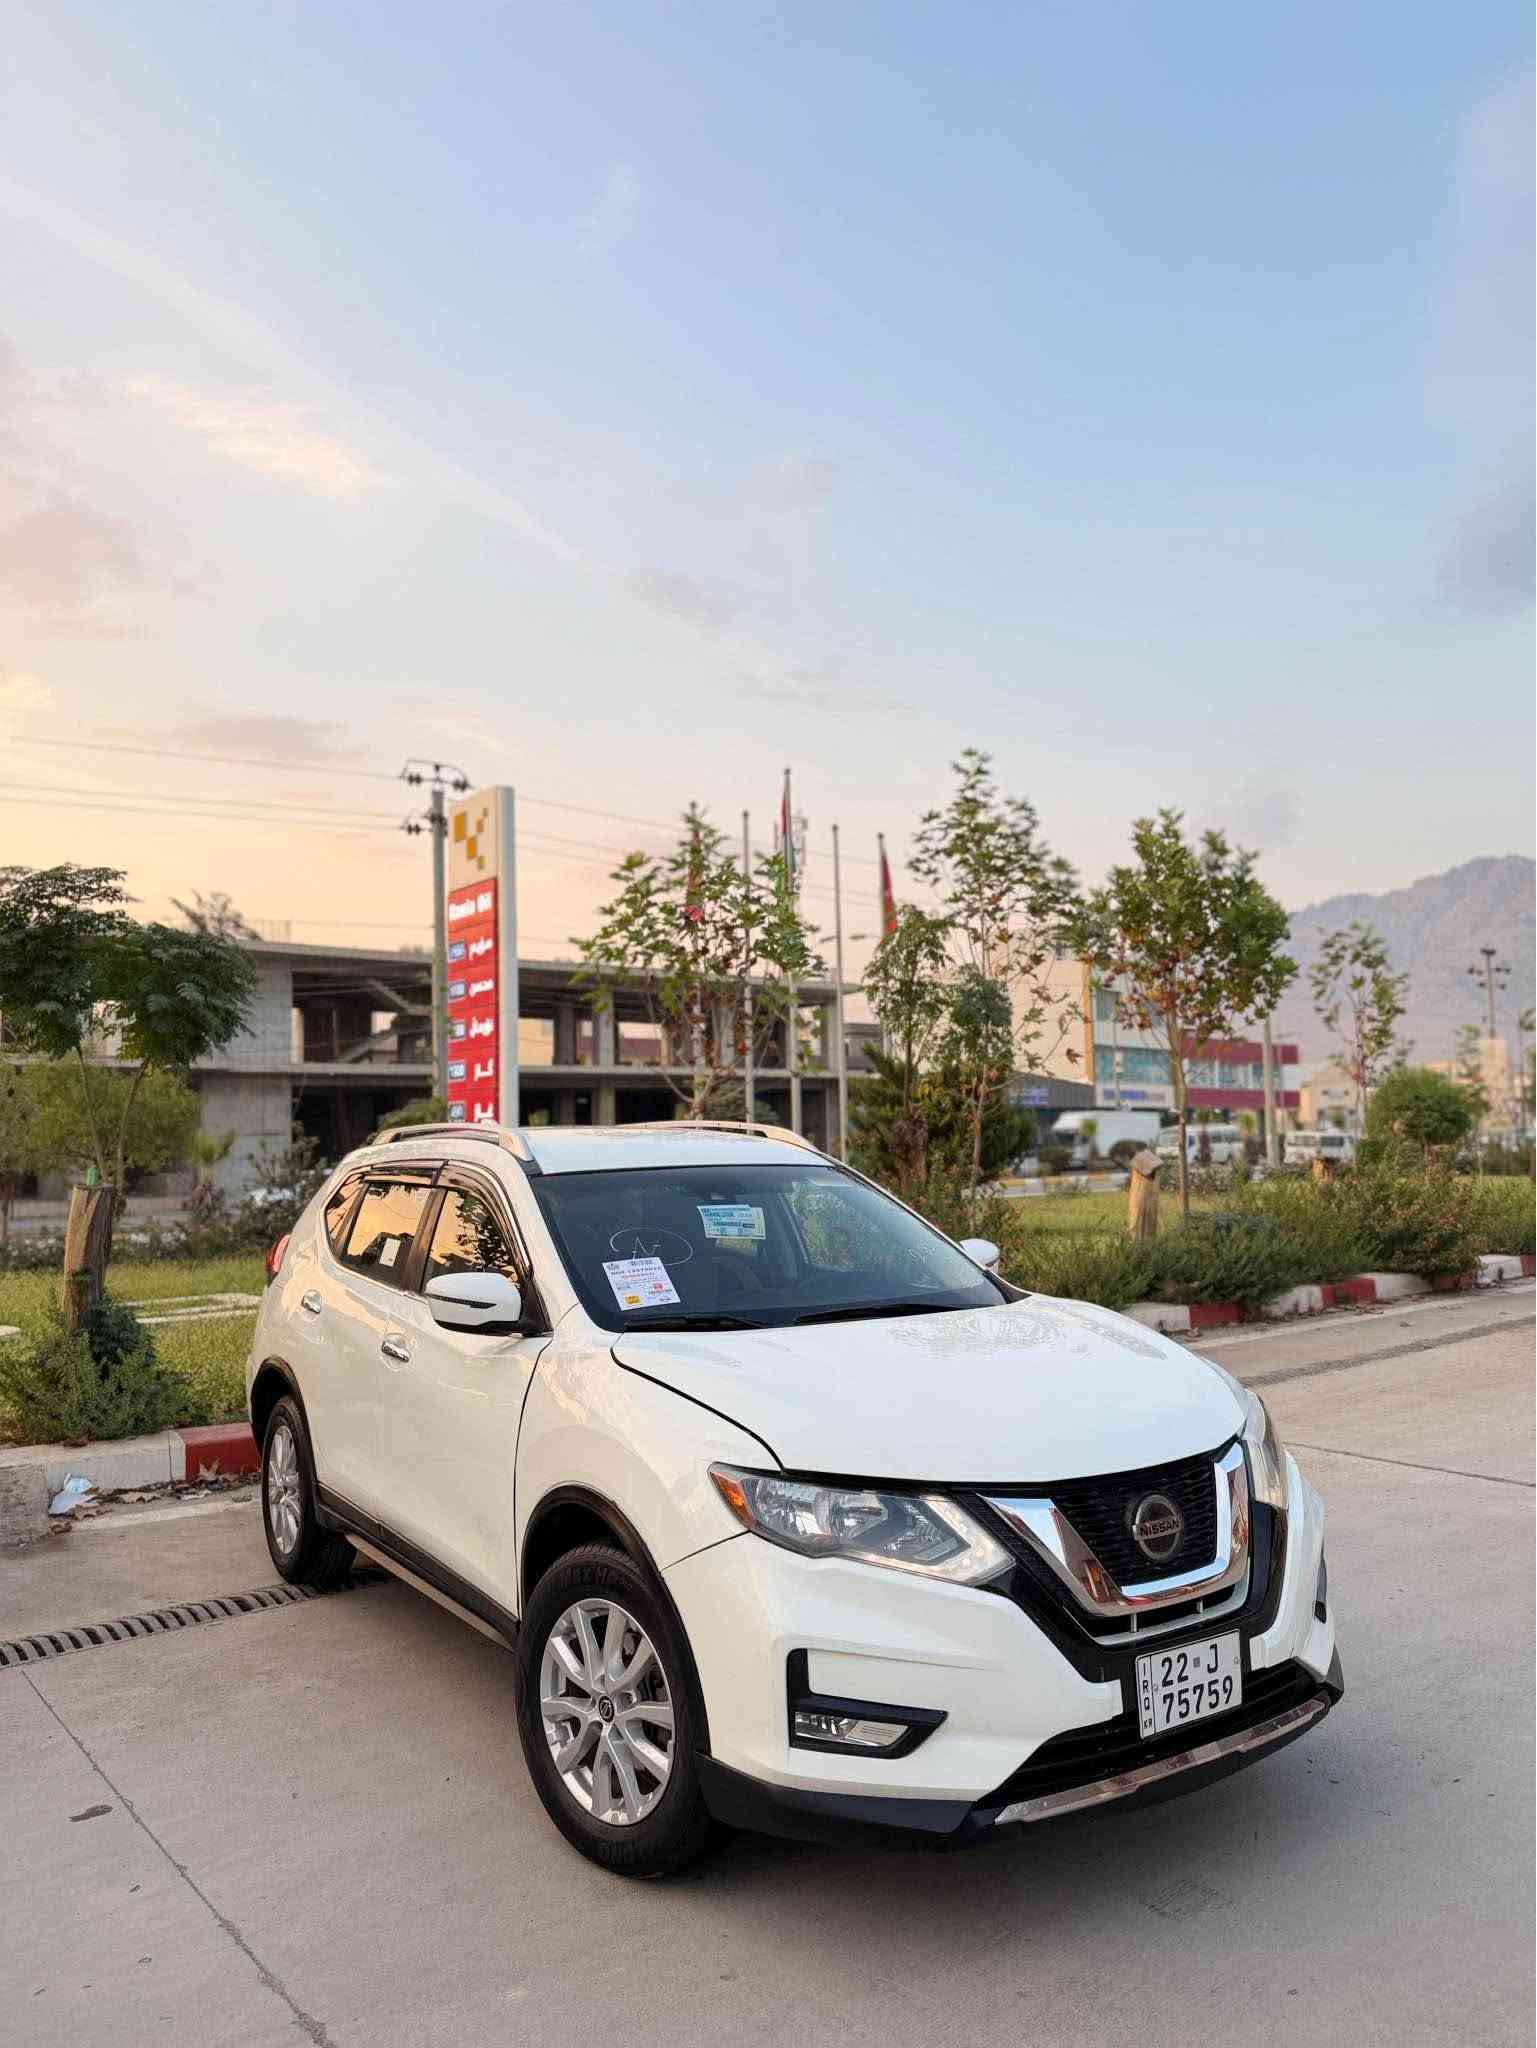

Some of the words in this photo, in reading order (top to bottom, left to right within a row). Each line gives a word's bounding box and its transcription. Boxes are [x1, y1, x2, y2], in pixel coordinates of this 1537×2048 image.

[1138, 1519, 1180, 1537] NISSAN
[1161, 1652, 1189, 1687] 22
[1206, 1643, 1218, 1674] J
[1163, 1675, 1233, 1724] 75759
